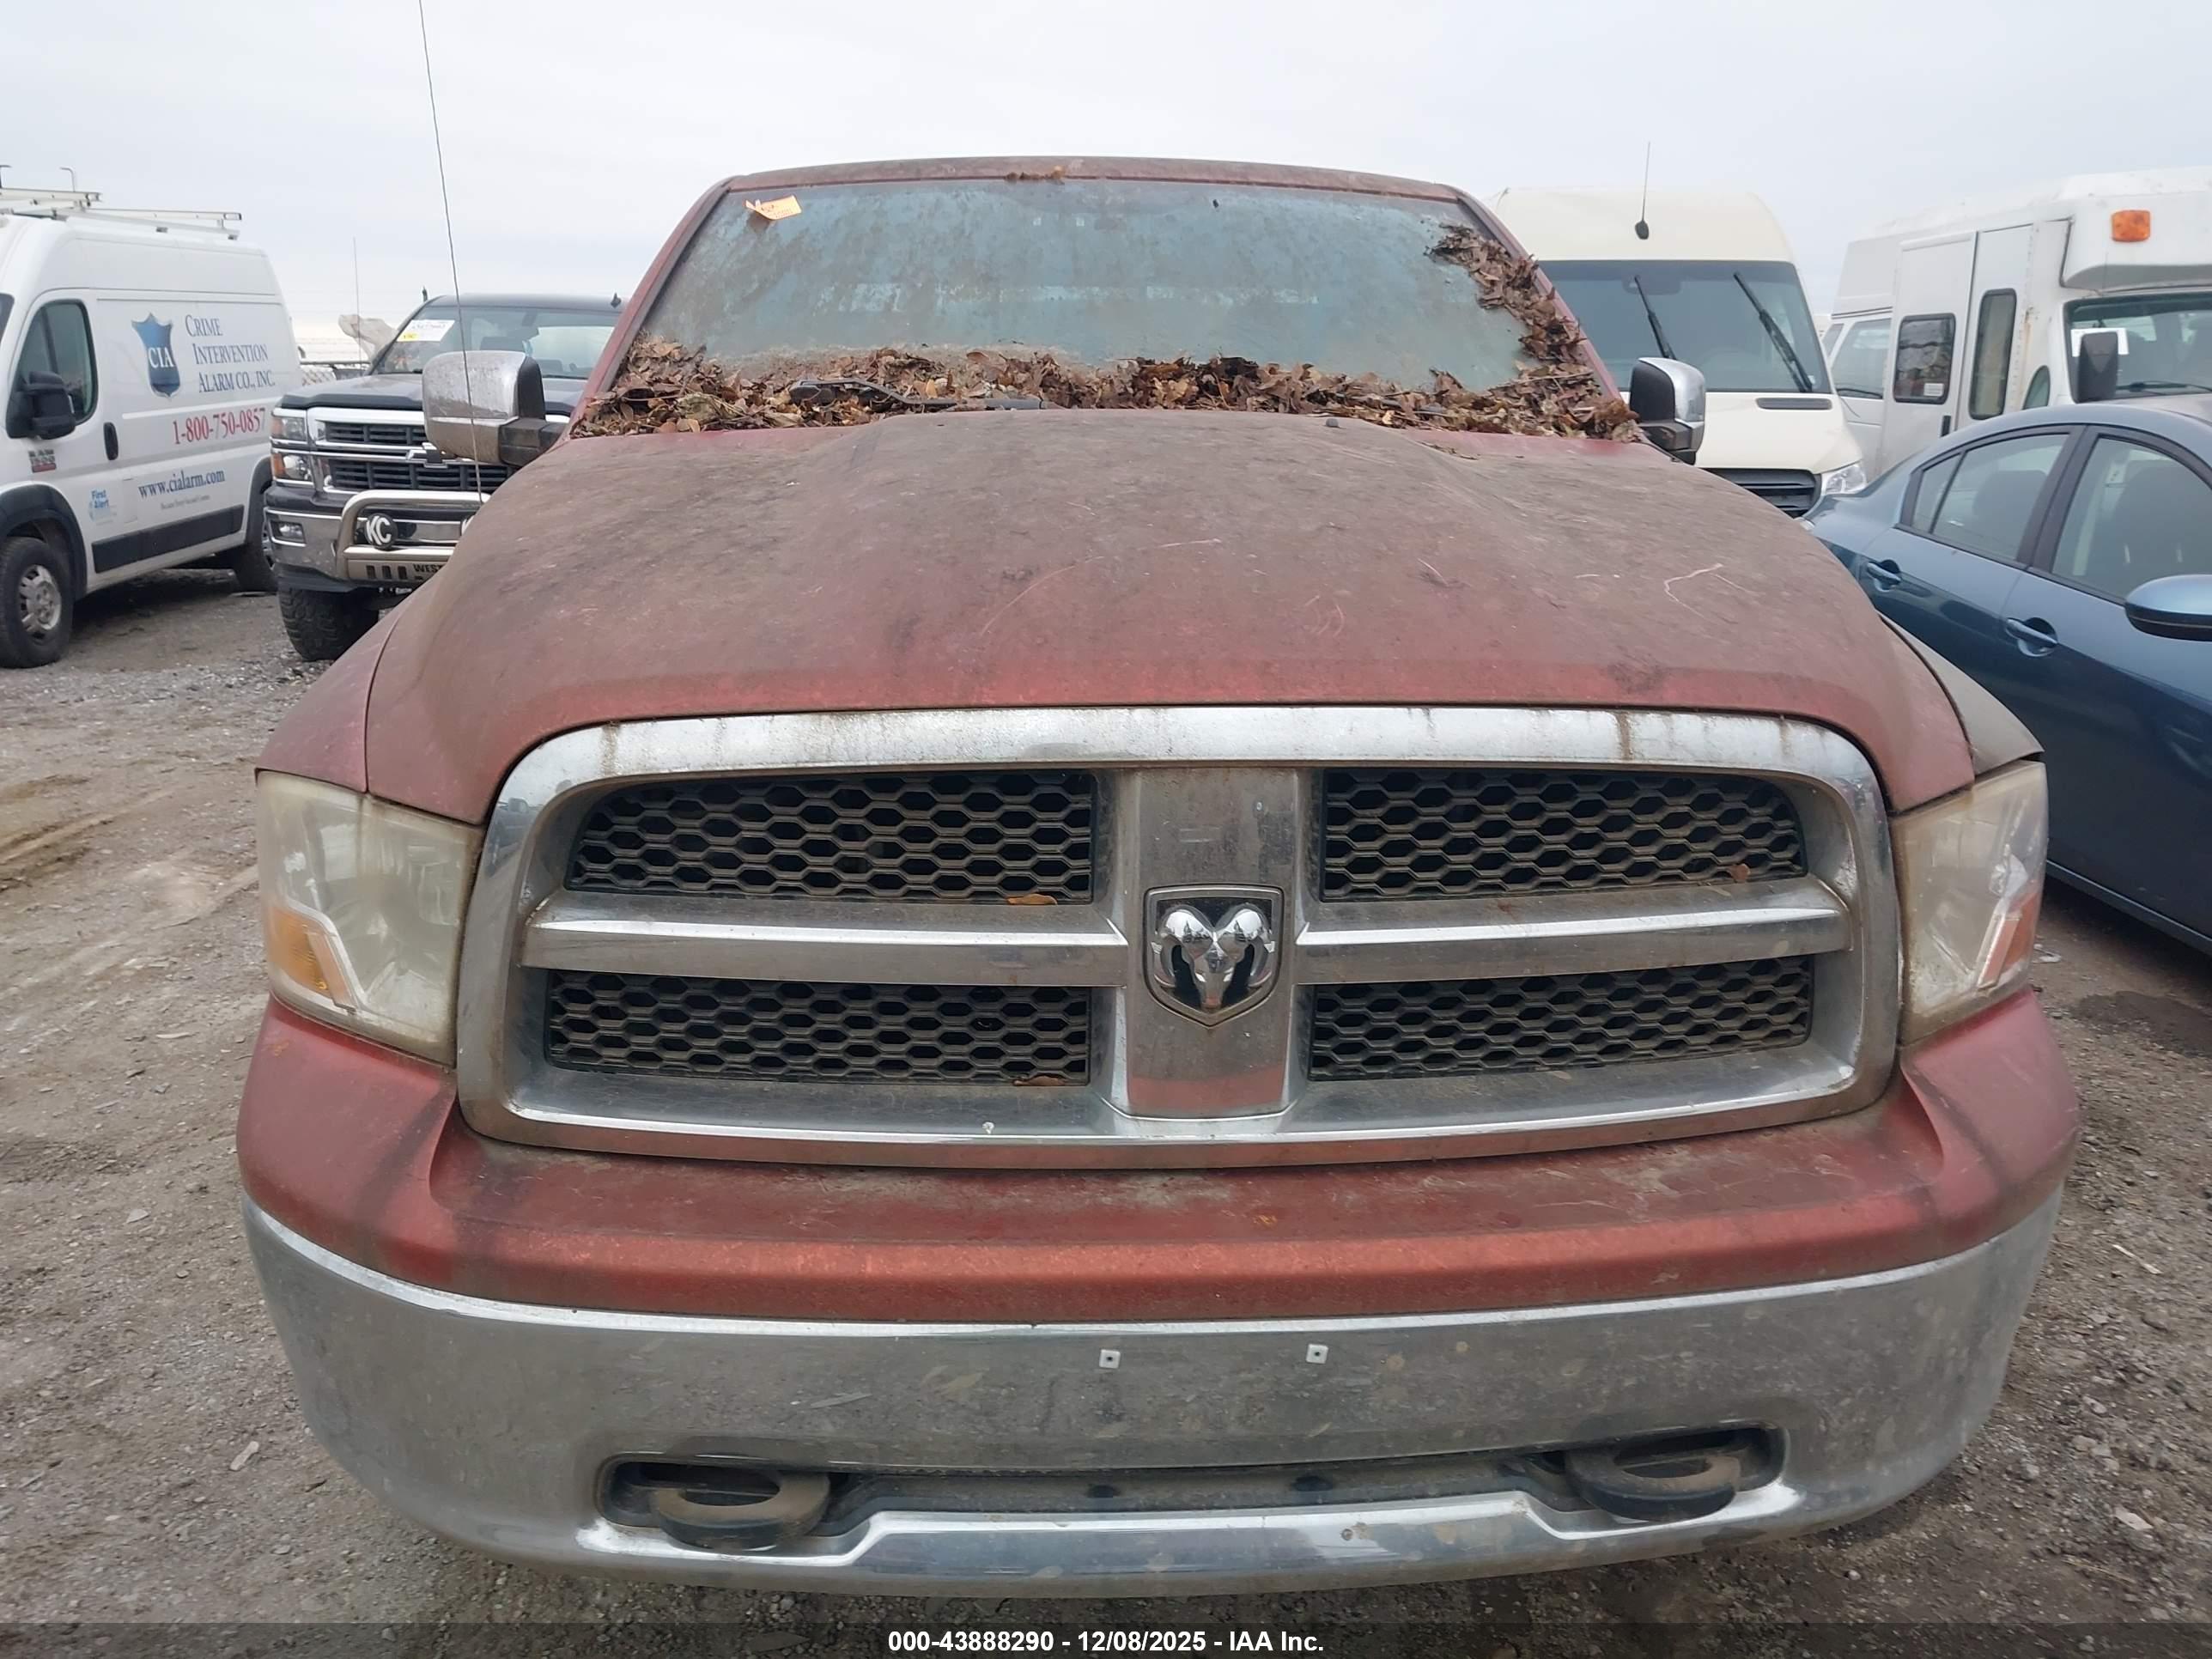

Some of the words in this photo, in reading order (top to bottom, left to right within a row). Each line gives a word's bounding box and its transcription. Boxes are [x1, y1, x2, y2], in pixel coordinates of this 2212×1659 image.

[185, 314, 223, 337] CRIME
[148, 346, 174, 369] CIA
[192, 343, 270, 366] INTERVENTION
[198, 372, 234, 393] ALARM
[173, 407, 265, 445] 1-800-750-0857
[137, 470, 226, 500] www.cialarm.com
[366, 515, 392, 546] KC
